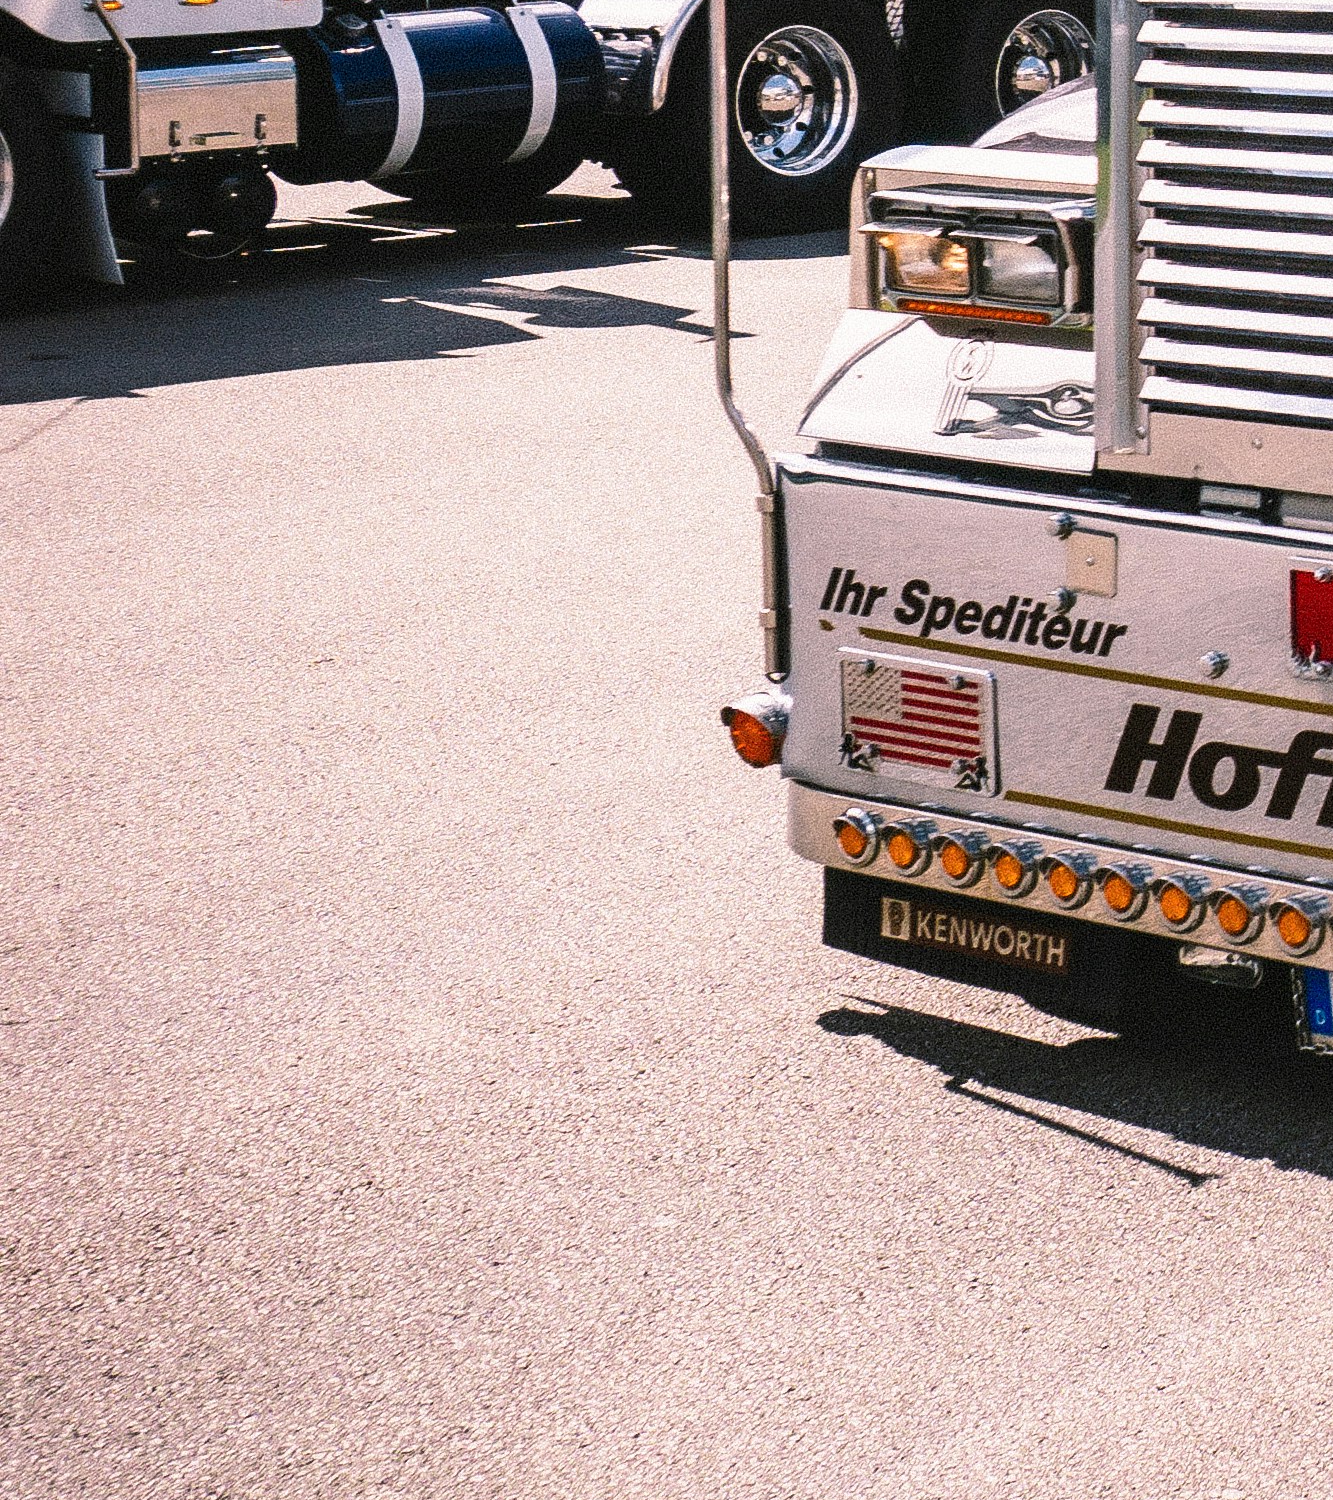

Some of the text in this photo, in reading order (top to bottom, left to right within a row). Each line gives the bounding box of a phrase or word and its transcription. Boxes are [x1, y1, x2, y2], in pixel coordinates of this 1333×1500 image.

[819, 566, 1129, 657] Ihr Spediteur
[916, 910, 1066, 968] KENWORTH
